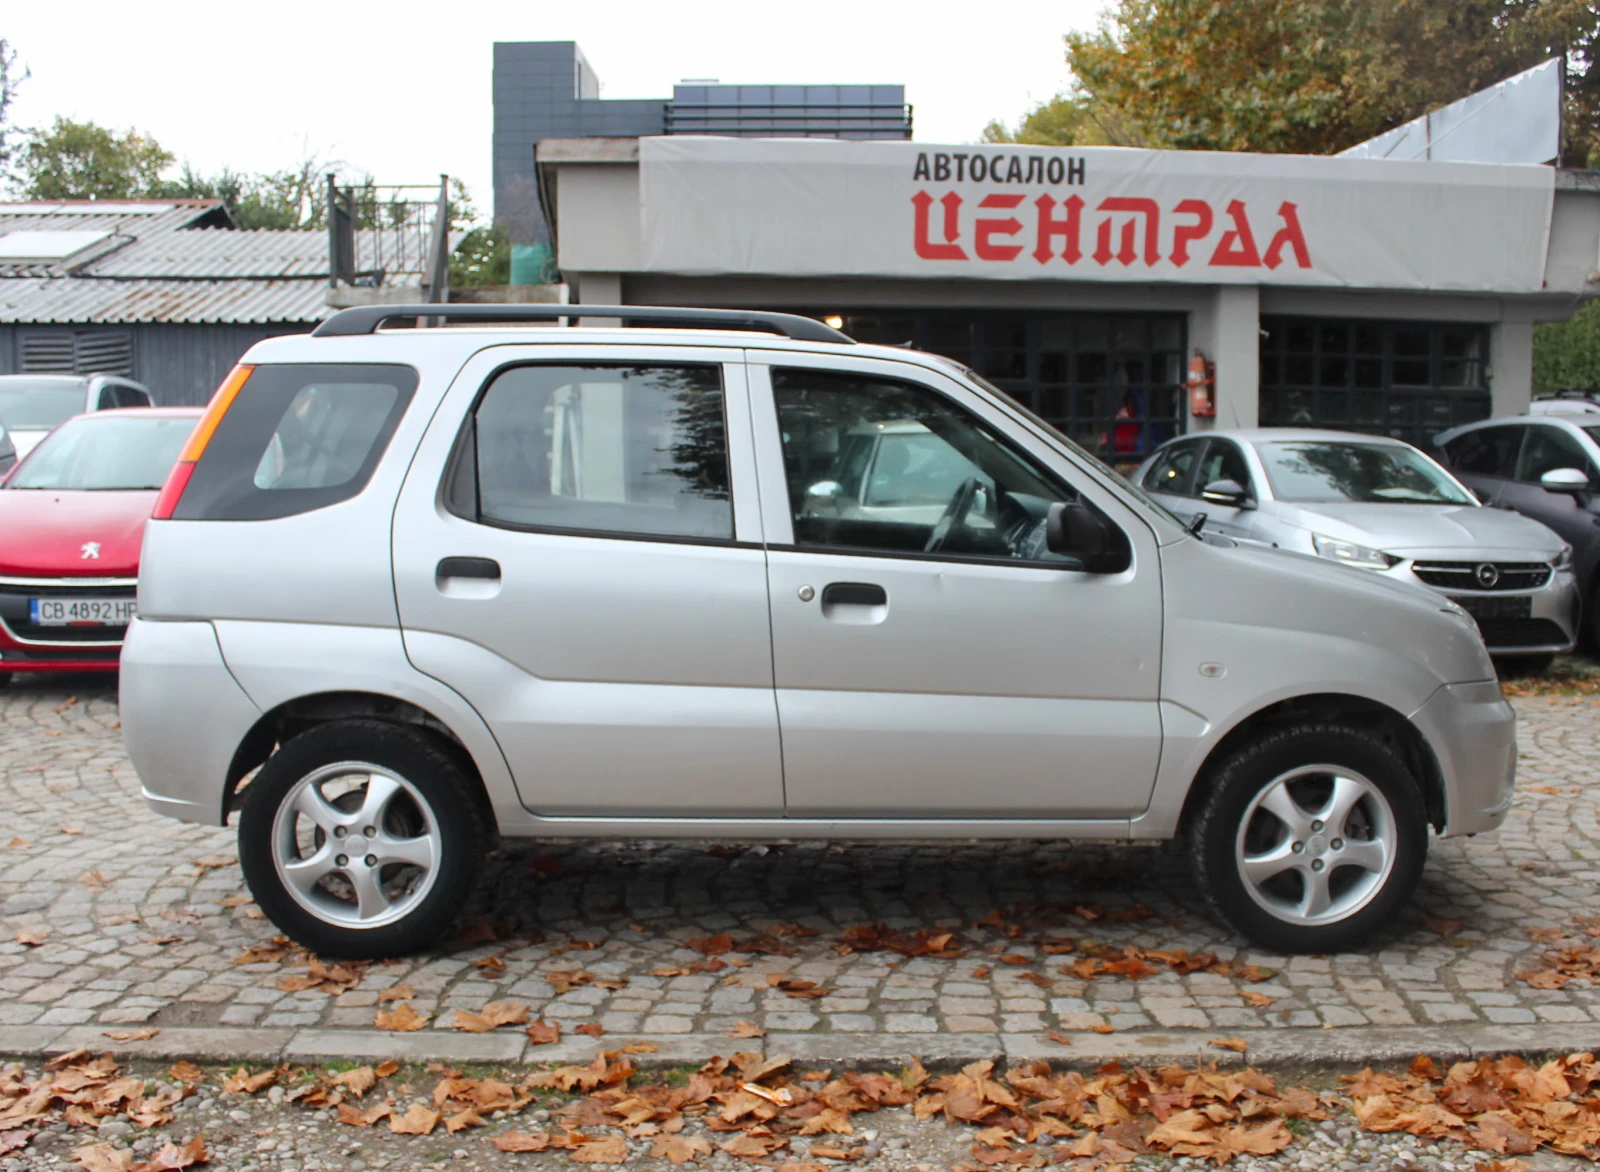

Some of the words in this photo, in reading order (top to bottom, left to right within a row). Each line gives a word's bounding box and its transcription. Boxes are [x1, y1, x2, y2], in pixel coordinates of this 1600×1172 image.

[913, 152, 1085, 185] АВТОСАЛОН
[910, 189, 1313, 271] ЦЕНТРАЛ
[41, 602, 65, 619] CB
[68, 602, 112, 619] 4892
